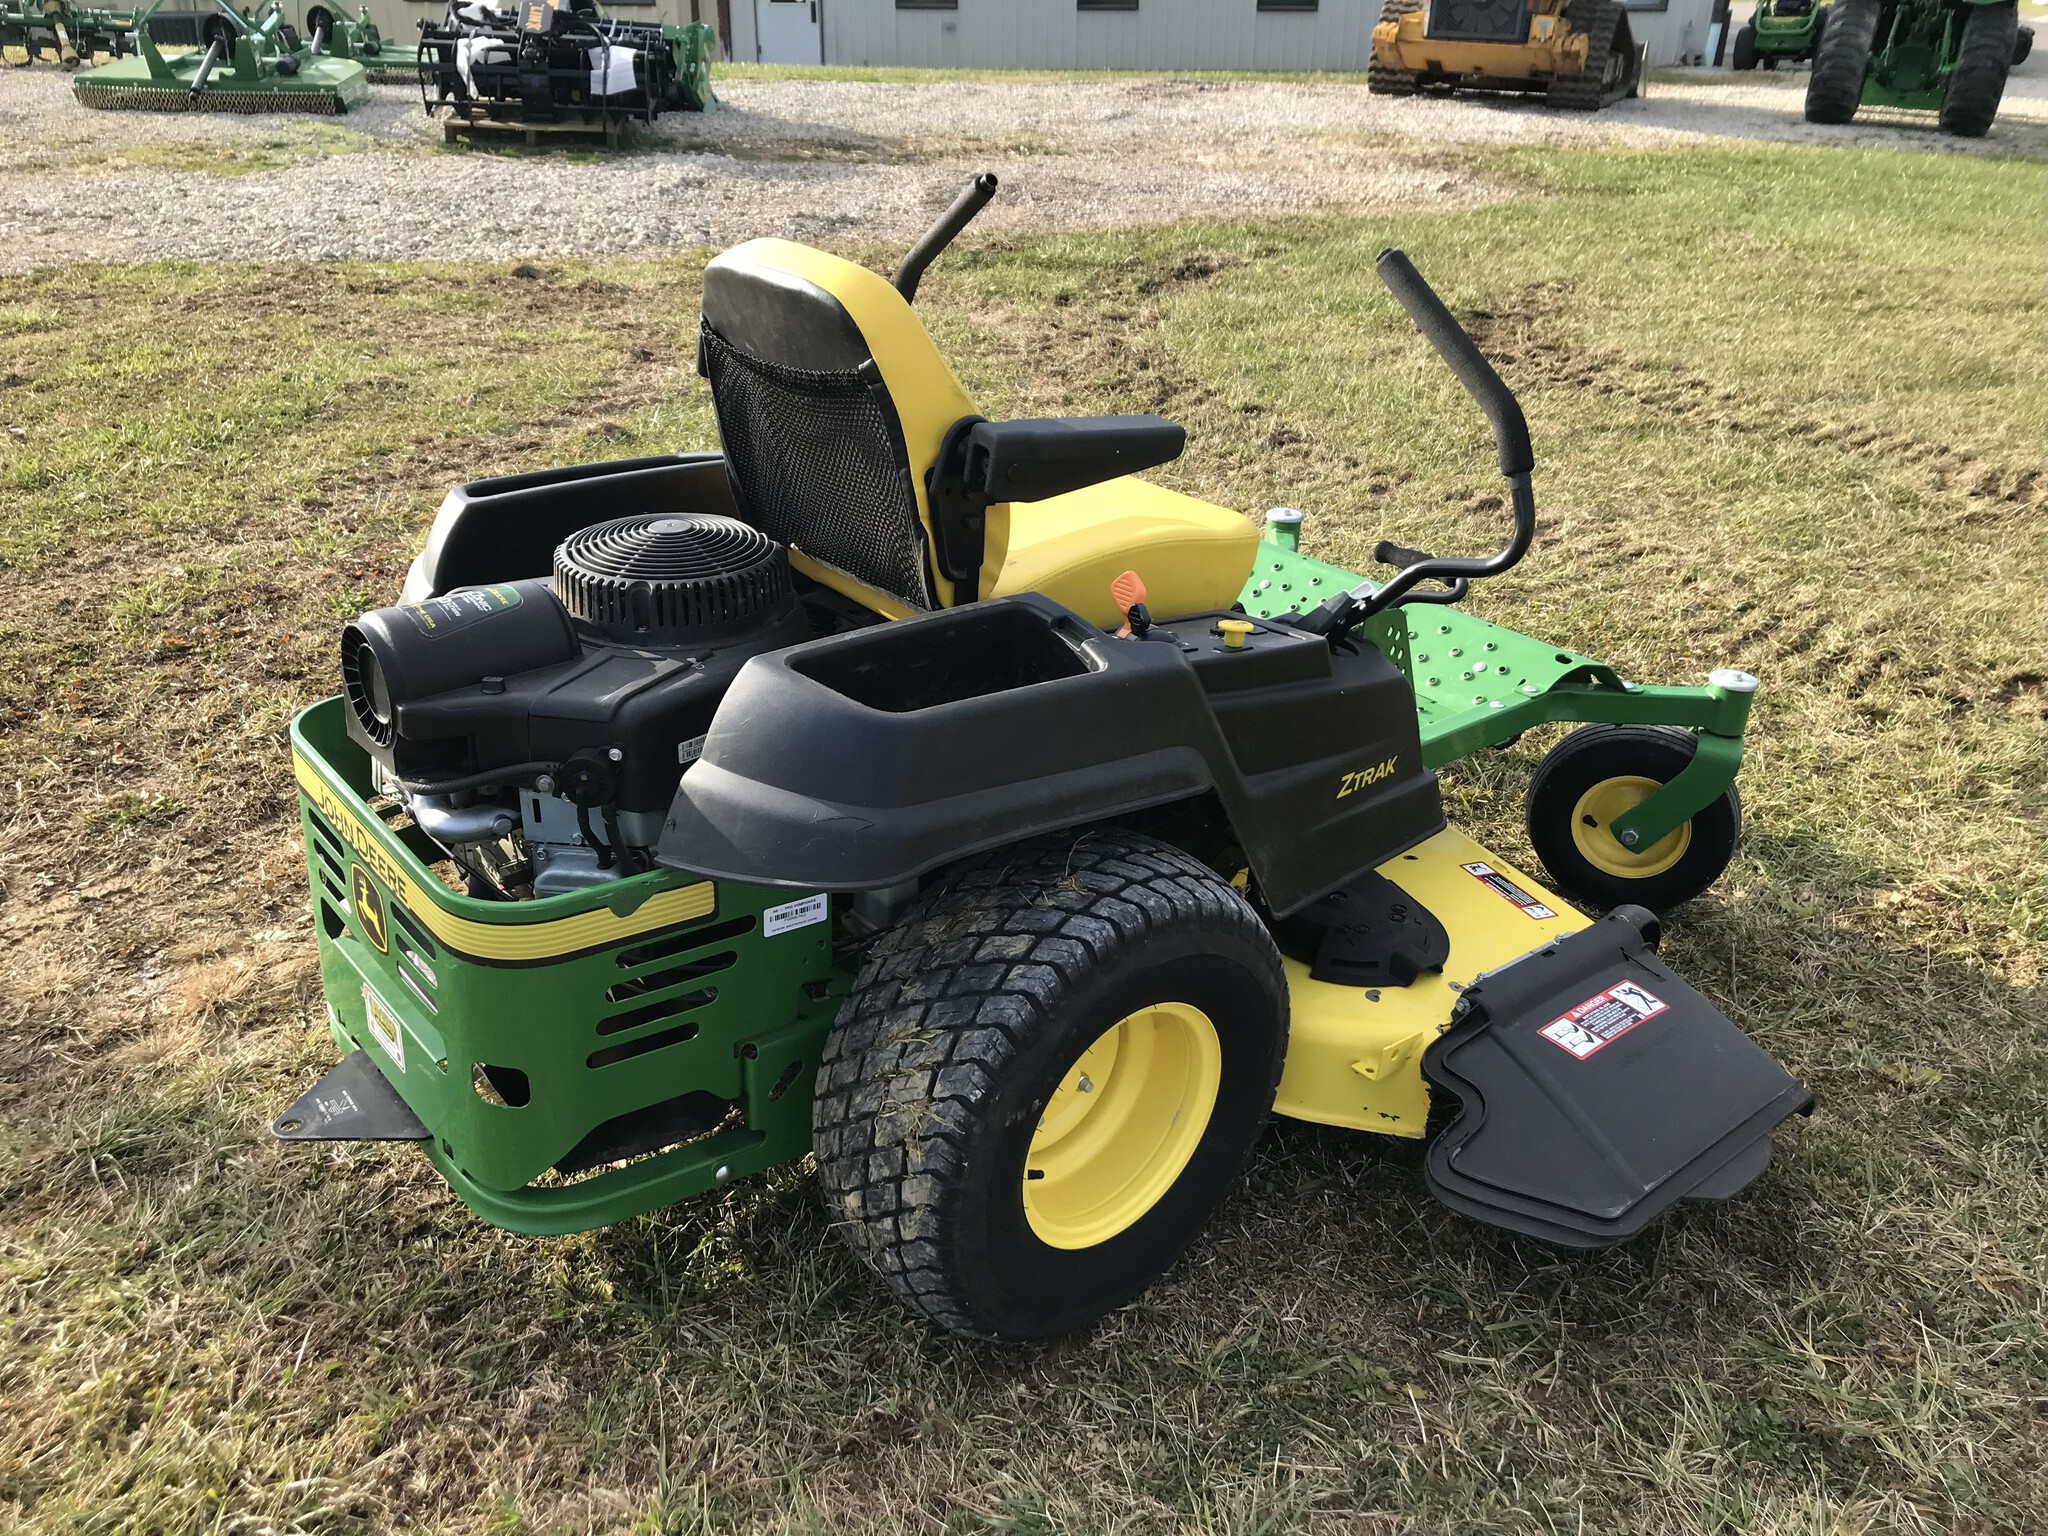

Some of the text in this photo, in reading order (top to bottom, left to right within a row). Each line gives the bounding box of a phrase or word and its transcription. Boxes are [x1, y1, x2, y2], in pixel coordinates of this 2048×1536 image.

[1336, 755, 1398, 799] ZTRAK
[317, 785, 409, 905] JOHN DEERE
[1576, 995, 1608, 1014] DANGER
